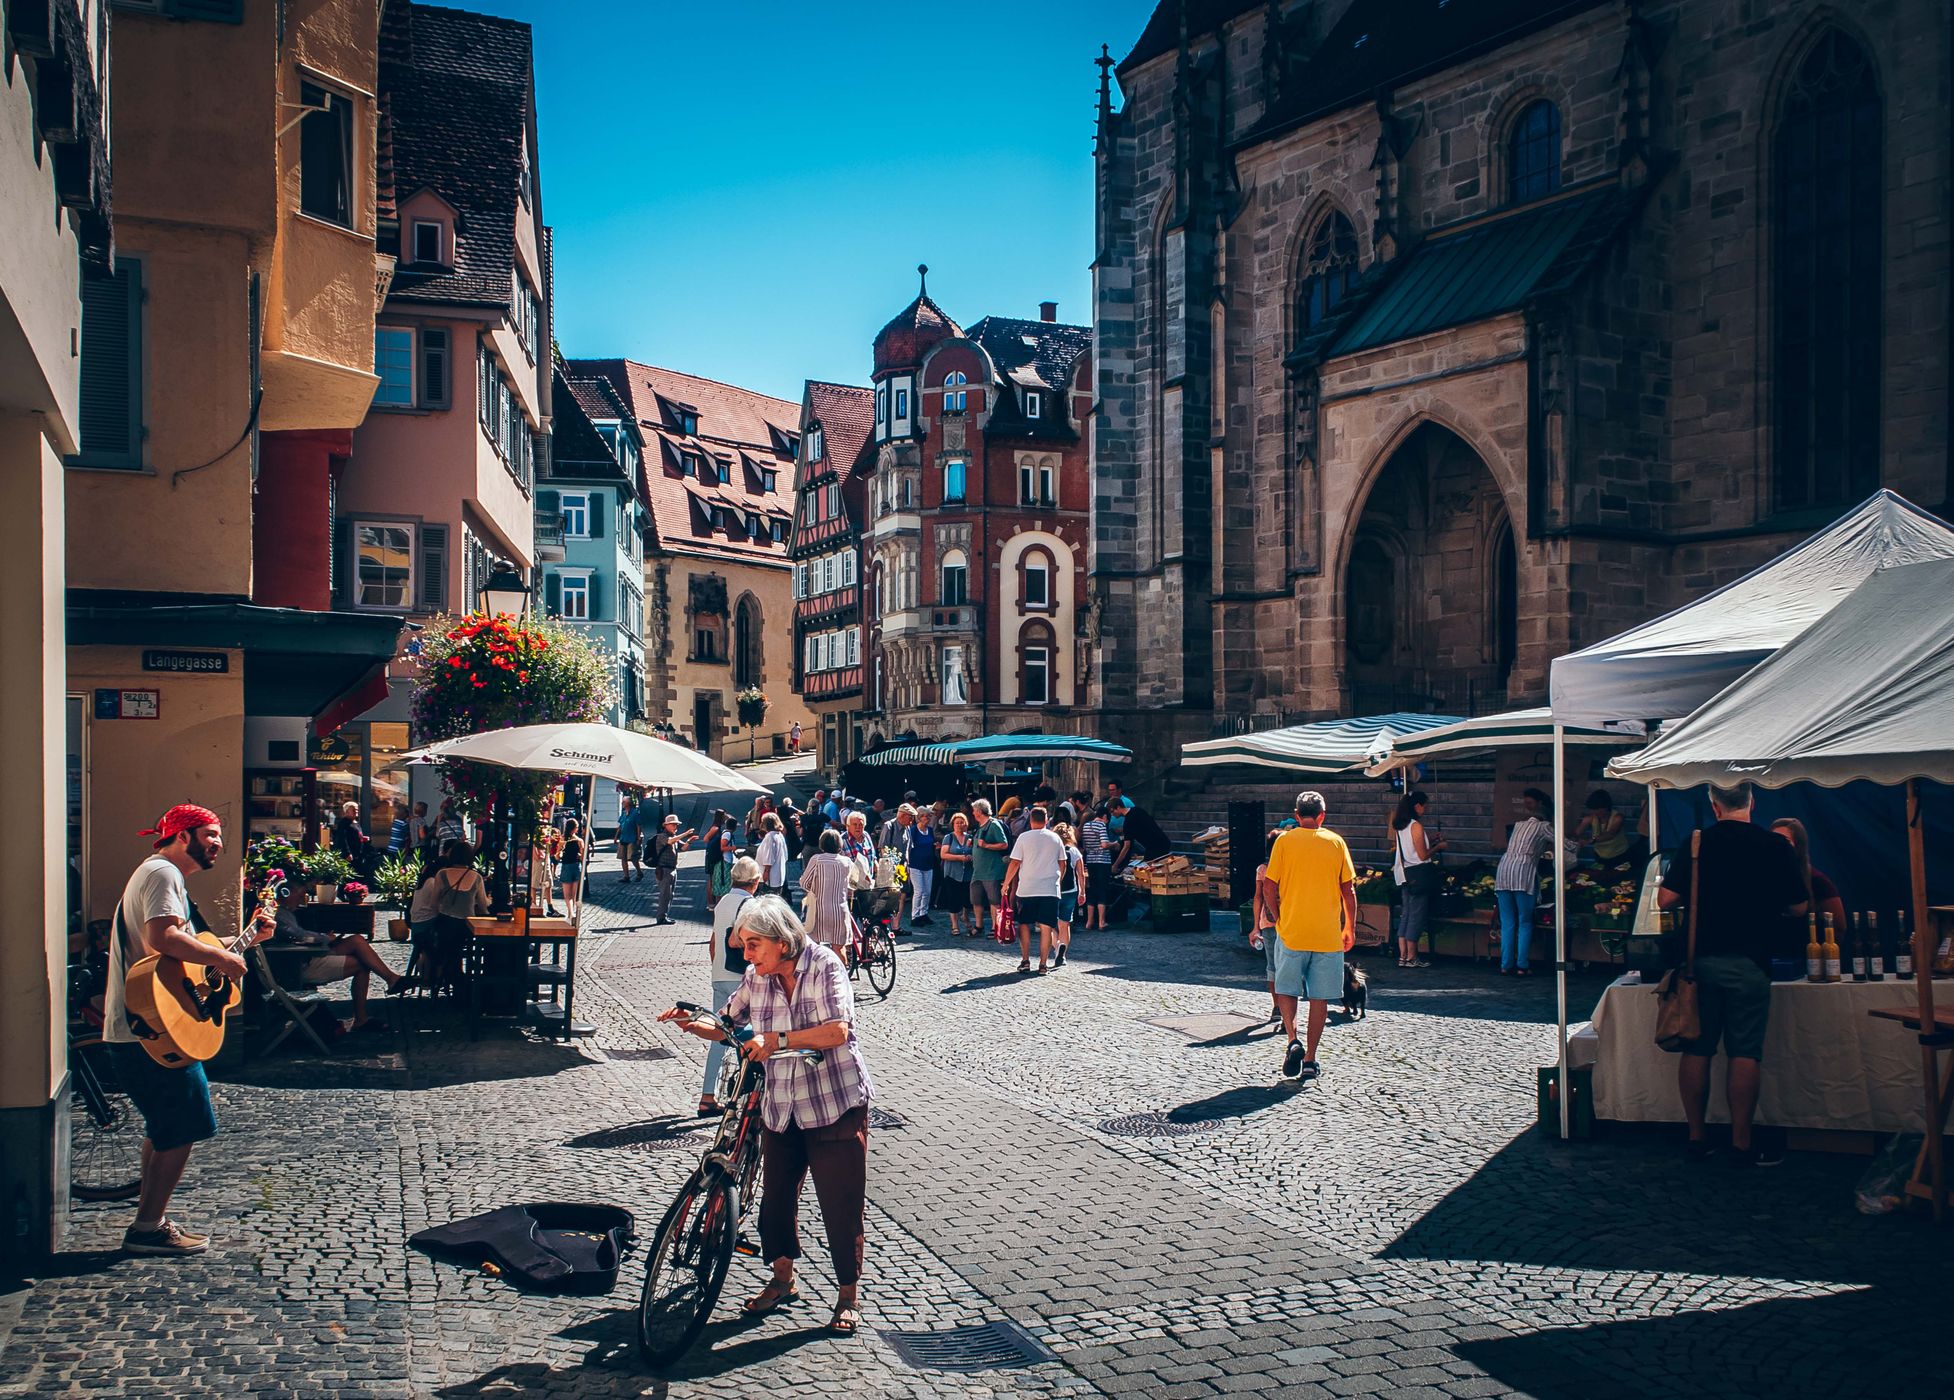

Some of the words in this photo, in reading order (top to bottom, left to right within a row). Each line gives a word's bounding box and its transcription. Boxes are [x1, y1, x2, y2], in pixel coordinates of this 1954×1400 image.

[149, 654, 222, 670] Langegasse
[310, 752, 345, 761] Tchibo
[550, 748, 615, 763] Schimpf
